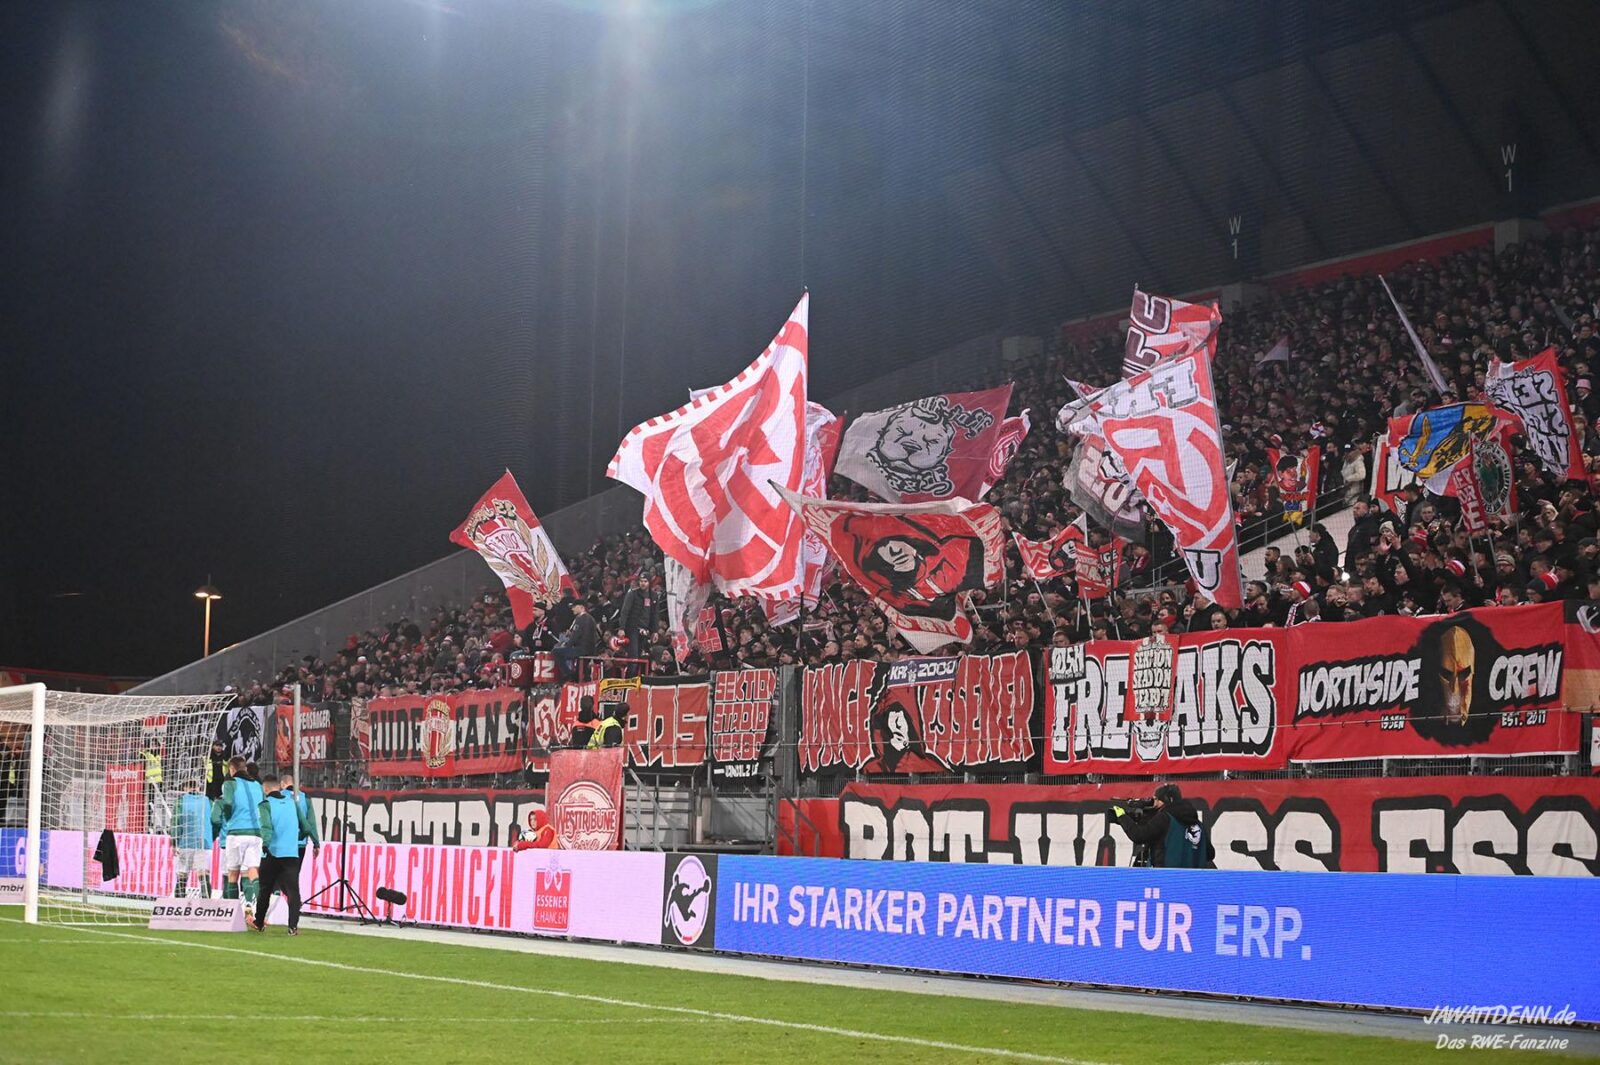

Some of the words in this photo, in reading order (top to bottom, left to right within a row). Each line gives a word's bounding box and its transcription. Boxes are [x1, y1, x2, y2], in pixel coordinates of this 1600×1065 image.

[1501, 144, 1516, 166] W
[1505, 169, 1512, 192] 1
[1229, 215, 1242, 235] W
[1231, 239, 1237, 259] 1
[916, 660, 957, 679] 2000
[1297, 657, 1422, 716] NORTHSIDE
[1488, 649, 1563, 701] CREW
[713, 700, 771, 733] STADIO
[798, 658, 878, 774] JUNGE
[921, 650, 1037, 767] ESSENER
[454, 699, 522, 761] FANS
[555, 802, 617, 838] WESTTRIBÜNE
[310, 842, 397, 914] ESSENER
[405, 846, 515, 929] CHANCEN
[166, 906, 192, 917] B&B
[194, 907, 235, 918] GmbH
[536, 896, 569, 910] ESSENER
[733, 882, 779, 924] IHR
[788, 885, 926, 936] STARKER
[937, 892, 1101, 947] PARTNER
[1115, 887, 1192, 953] FÜR
[1215, 903, 1312, 961] ERP.
